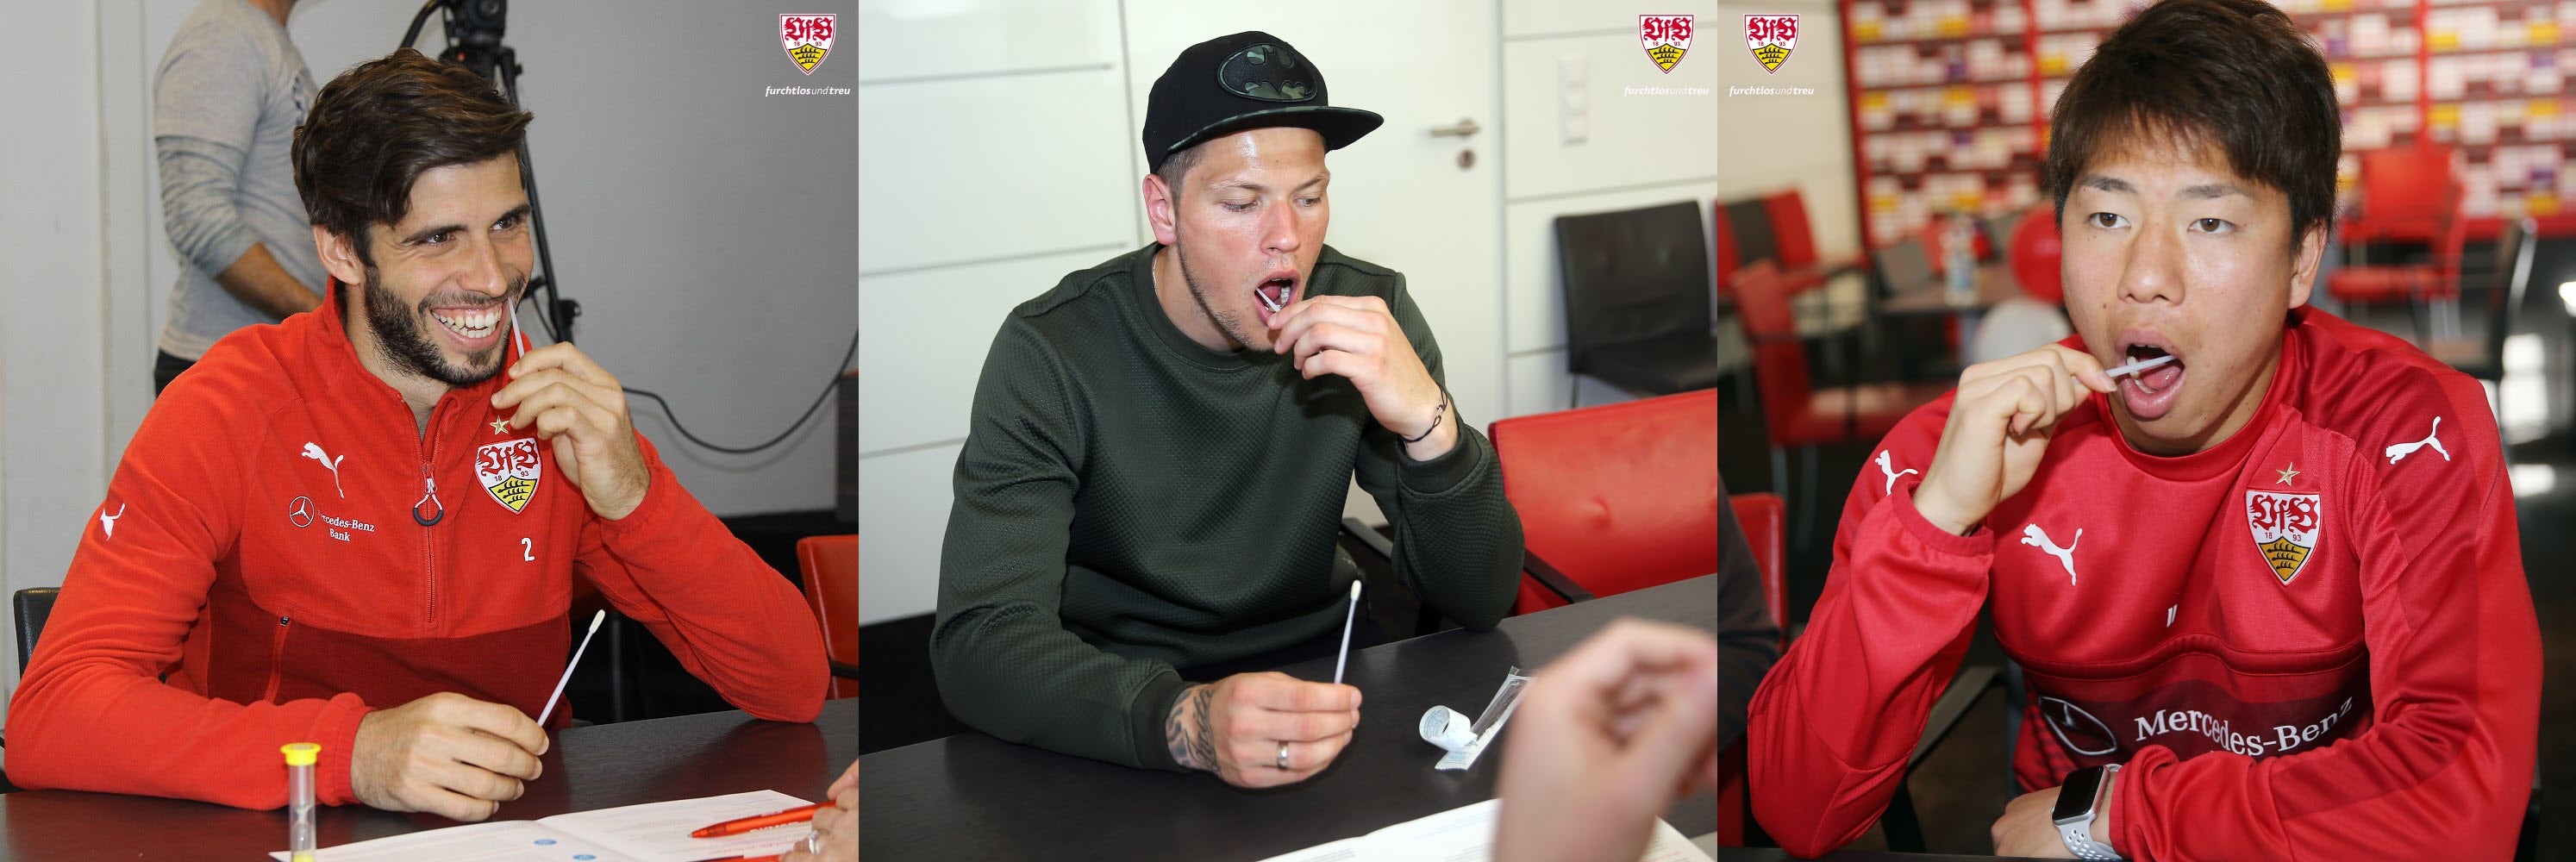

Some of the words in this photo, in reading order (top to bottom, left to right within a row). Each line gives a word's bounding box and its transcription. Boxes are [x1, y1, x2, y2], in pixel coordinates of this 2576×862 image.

[476, 440, 539, 477] VfB
[2250, 495, 2318, 534] VfB
[329, 528, 350, 541] Bank
[521, 537, 535, 562] 2
[2134, 696, 2354, 757] Mercedes-Benz
